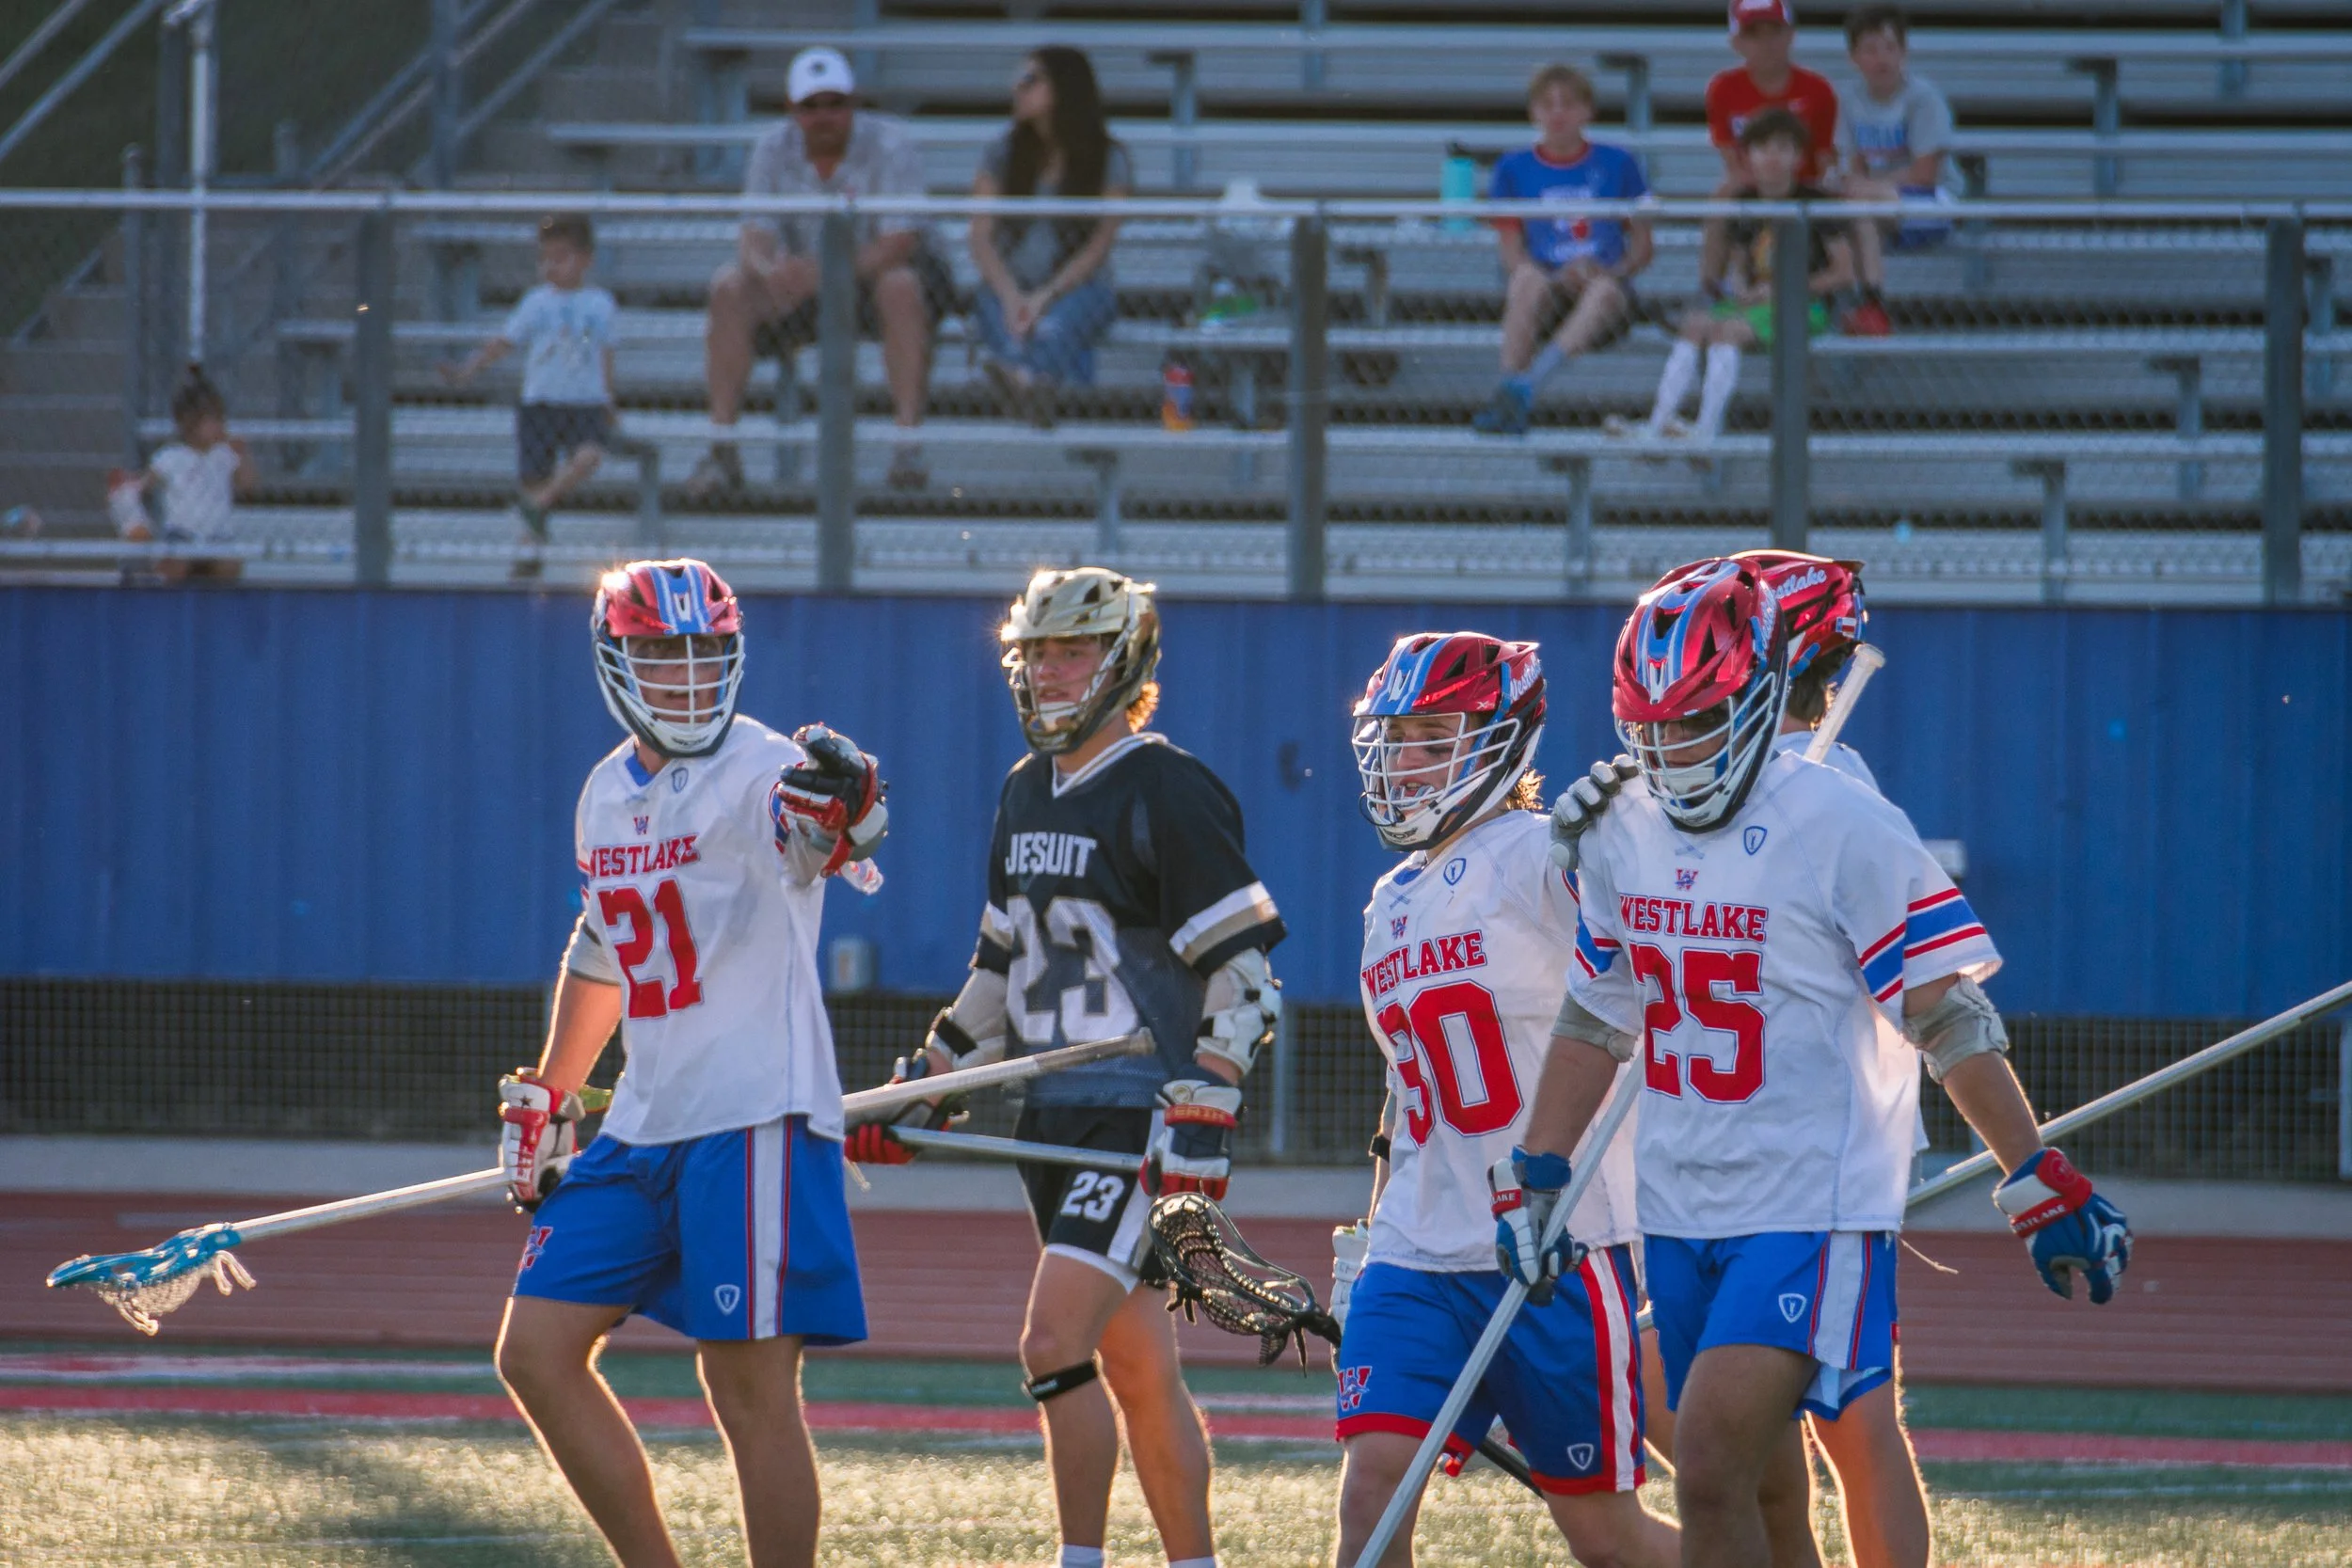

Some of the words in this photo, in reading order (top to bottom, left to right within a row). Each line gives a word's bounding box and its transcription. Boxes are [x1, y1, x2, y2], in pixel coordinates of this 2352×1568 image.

[1775, 566, 1827, 599] stlake
[1005, 832, 1097, 879] JESUIT
[596, 876, 705, 1020] 21
[1618, 893, 1769, 944] WESTLAKE
[1006, 894, 1138, 1046] 23
[1361, 929, 1487, 1004] WESTLAKE
[1629, 939, 1767, 1104] 25
[1376, 978, 1524, 1151] 30
[1060, 1171, 1125, 1222] 23
[1337, 1365, 1373, 1411] W
